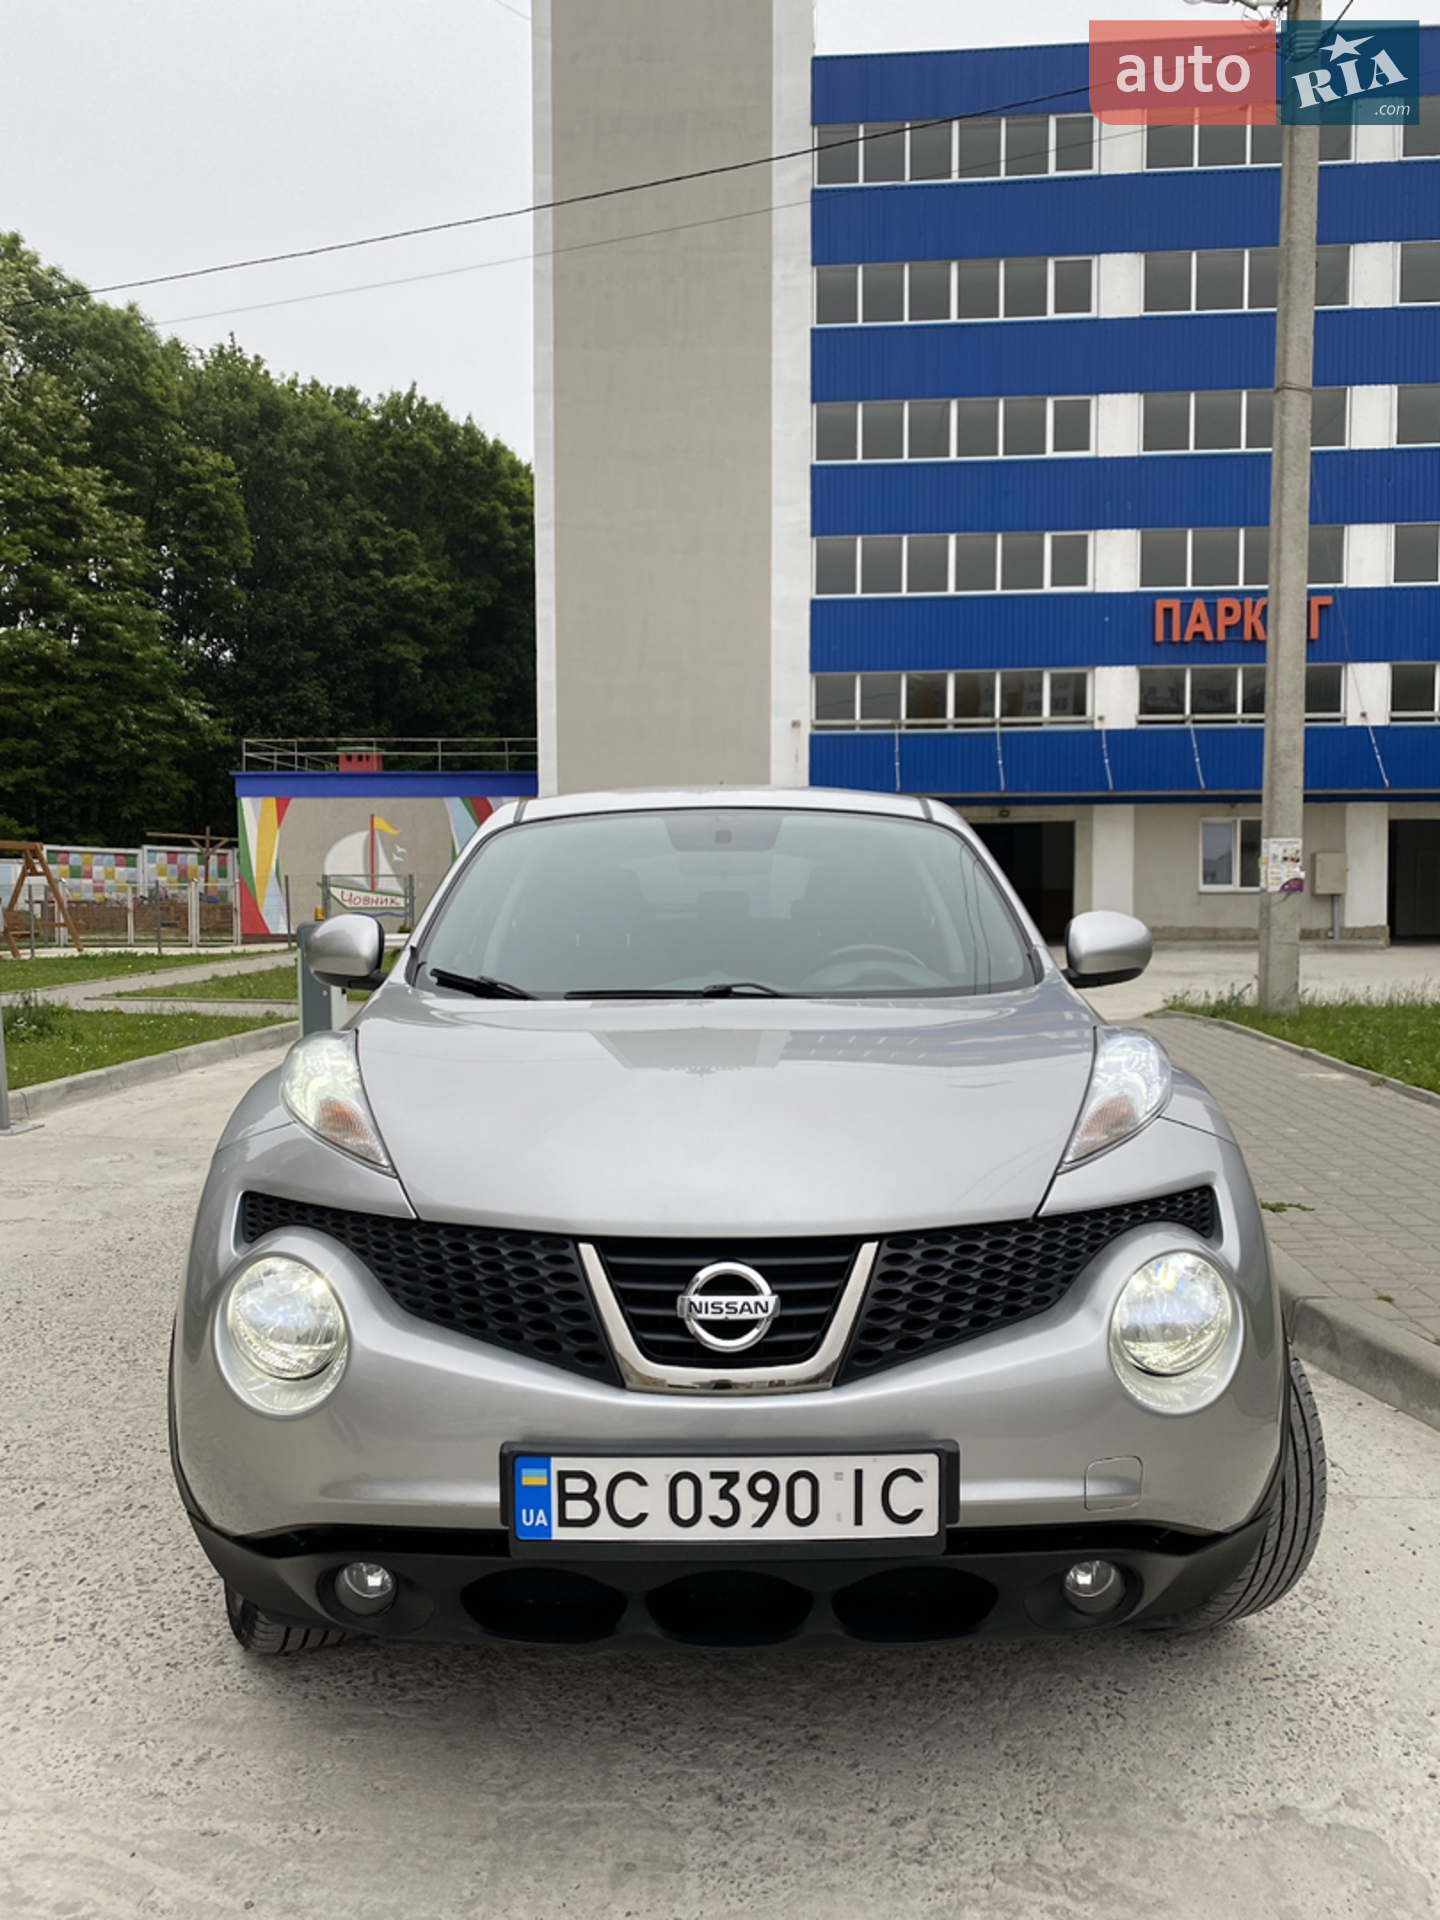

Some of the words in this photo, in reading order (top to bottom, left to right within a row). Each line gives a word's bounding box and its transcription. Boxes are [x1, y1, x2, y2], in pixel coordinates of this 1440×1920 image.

[1155, 596, 1334, 642] ПАРКГ
[340, 890, 401, 906] Човник
[689, 1300, 770, 1315] NISSAN
[522, 1508, 548, 1527] UA
[557, 1469, 649, 1528] BC
[668, 1469, 820, 1529] 0390
[853, 1467, 924, 1526] IC
